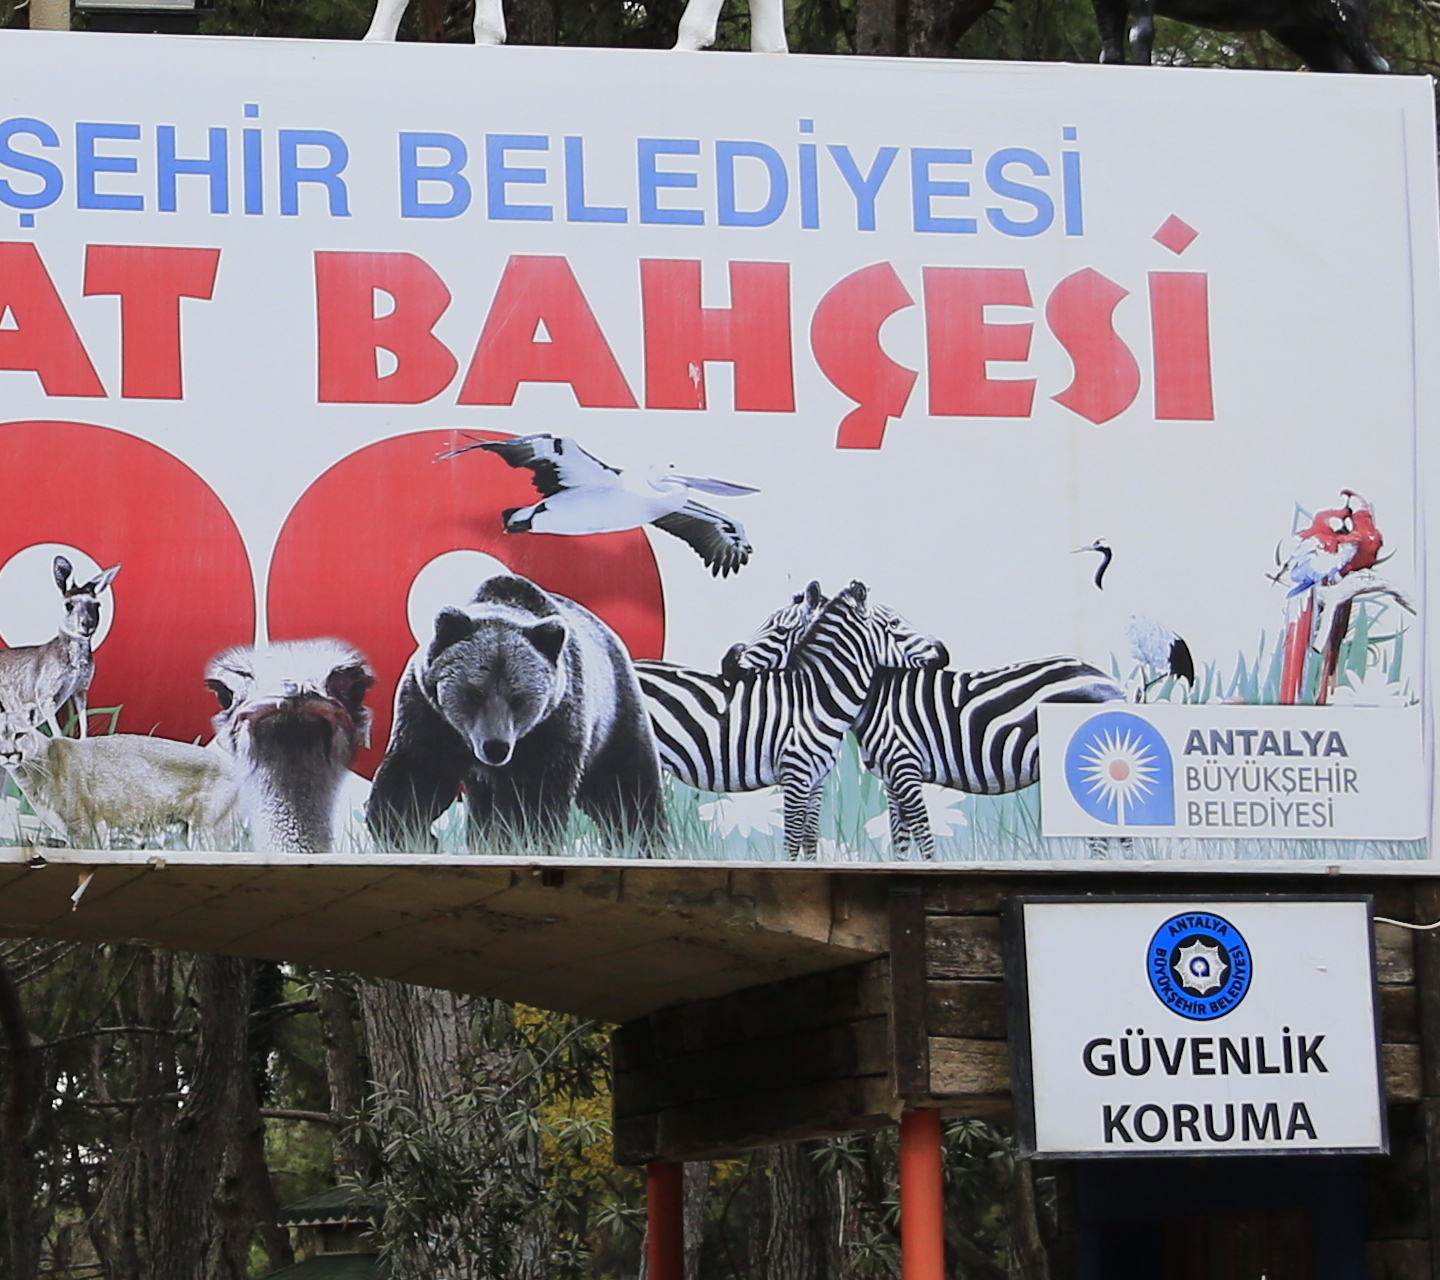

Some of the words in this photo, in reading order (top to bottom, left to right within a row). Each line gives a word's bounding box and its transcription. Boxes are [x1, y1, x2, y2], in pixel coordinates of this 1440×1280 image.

[397, 118, 1085, 238] BELEDİYESİ
[313, 213, 1215, 451] BAHÇESİ
[1183, 729, 1349, 757] ANTALYA
[1186, 759, 1360, 797] BÜYÜKŞEHİR
[1187, 797, 1335, 828] BELEDİYESİ
[1167, 916, 1228, 937] ANTALYA
[1154, 947, 1207, 1015] BÜYÜKŞEHİR
[1082, 1026, 1329, 1076] GÜVENLİK
[1102, 1102, 1318, 1143] KORUMA
